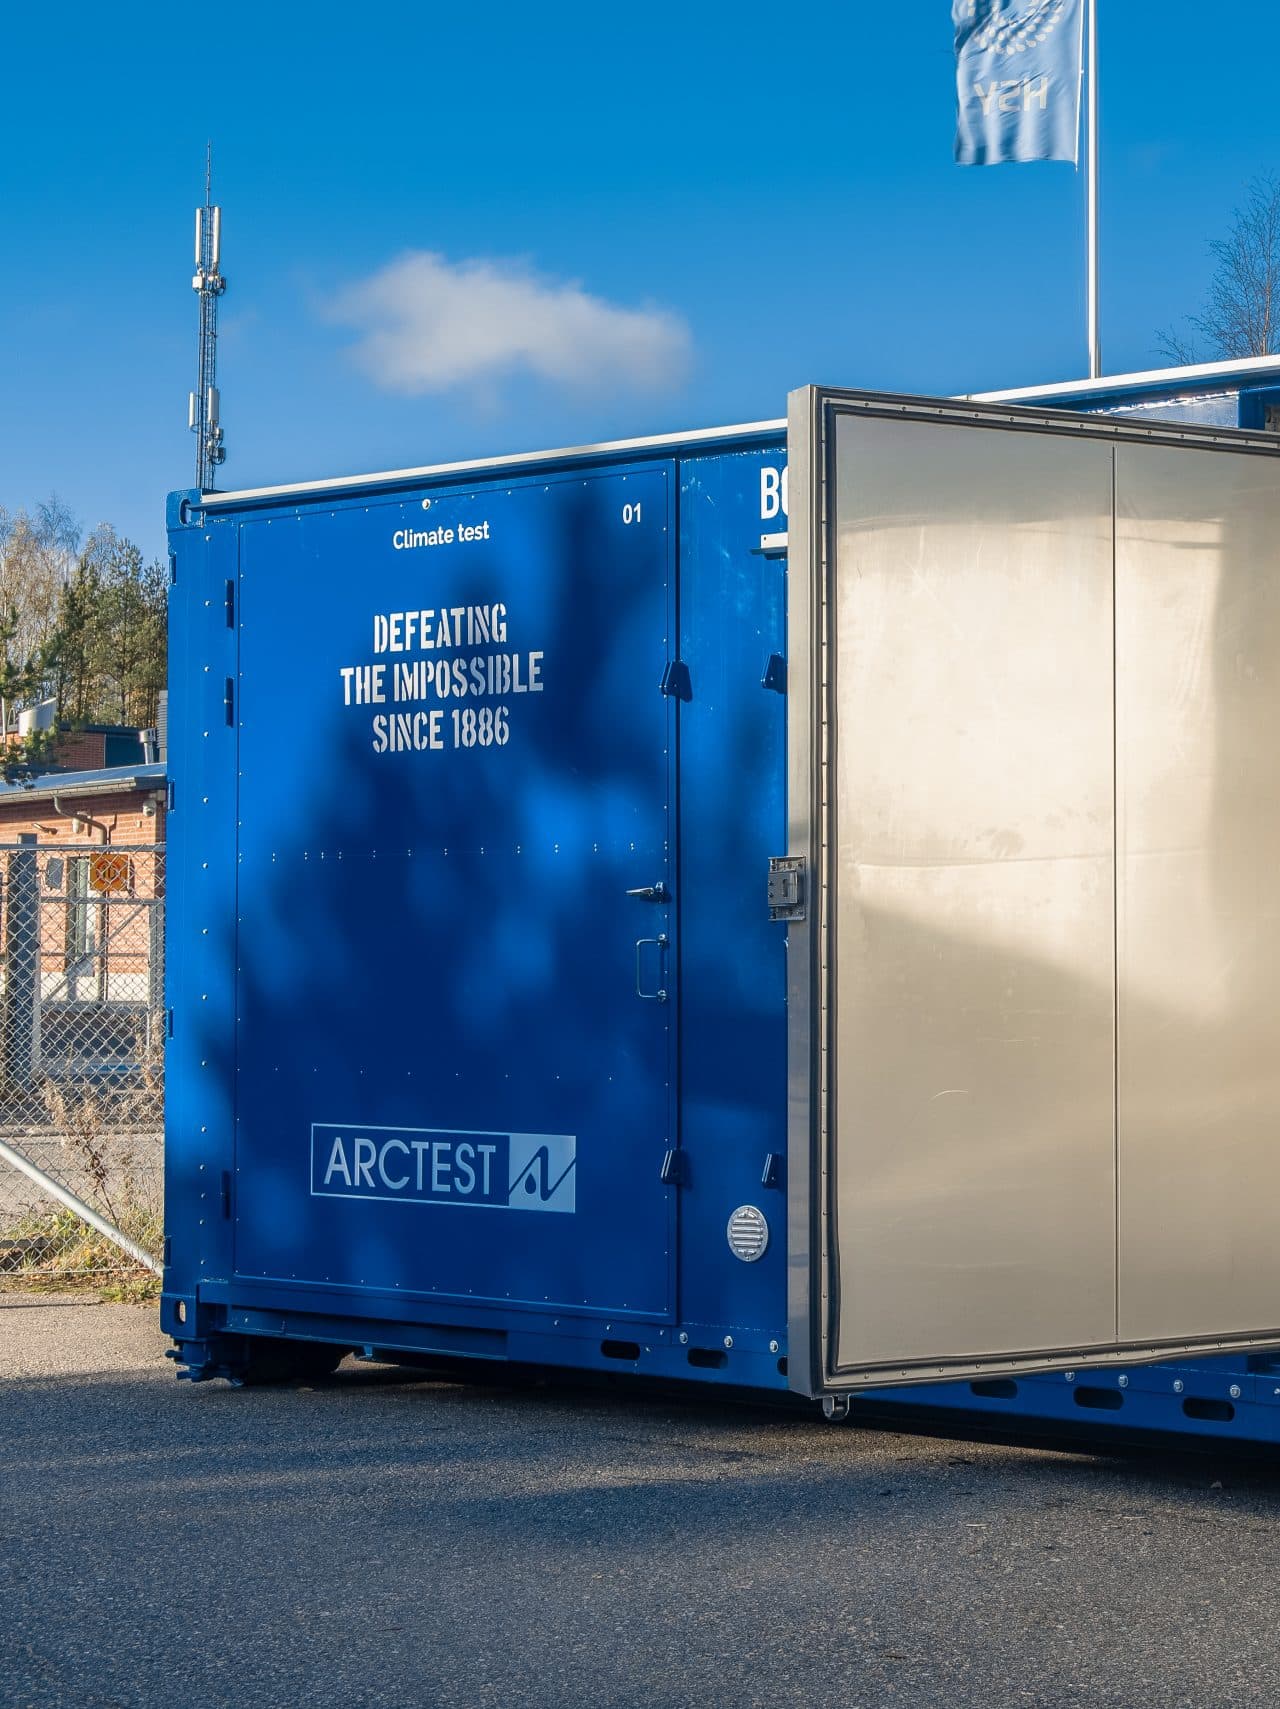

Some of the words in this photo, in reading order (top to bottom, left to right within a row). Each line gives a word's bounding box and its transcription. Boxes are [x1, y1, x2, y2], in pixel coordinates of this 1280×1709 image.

[393, 526, 454, 550] Climate
[458, 520, 490, 542] test
[622, 502, 641, 525] 01
[374, 603, 507, 653] DEFEATING
[340, 664, 386, 706] THE
[394, 651, 543, 702] IMPOSSIBLE
[372, 710, 444, 753] SINCE
[452, 706, 509, 749] 1886
[323, 1136, 496, 1195] ARCTEST
